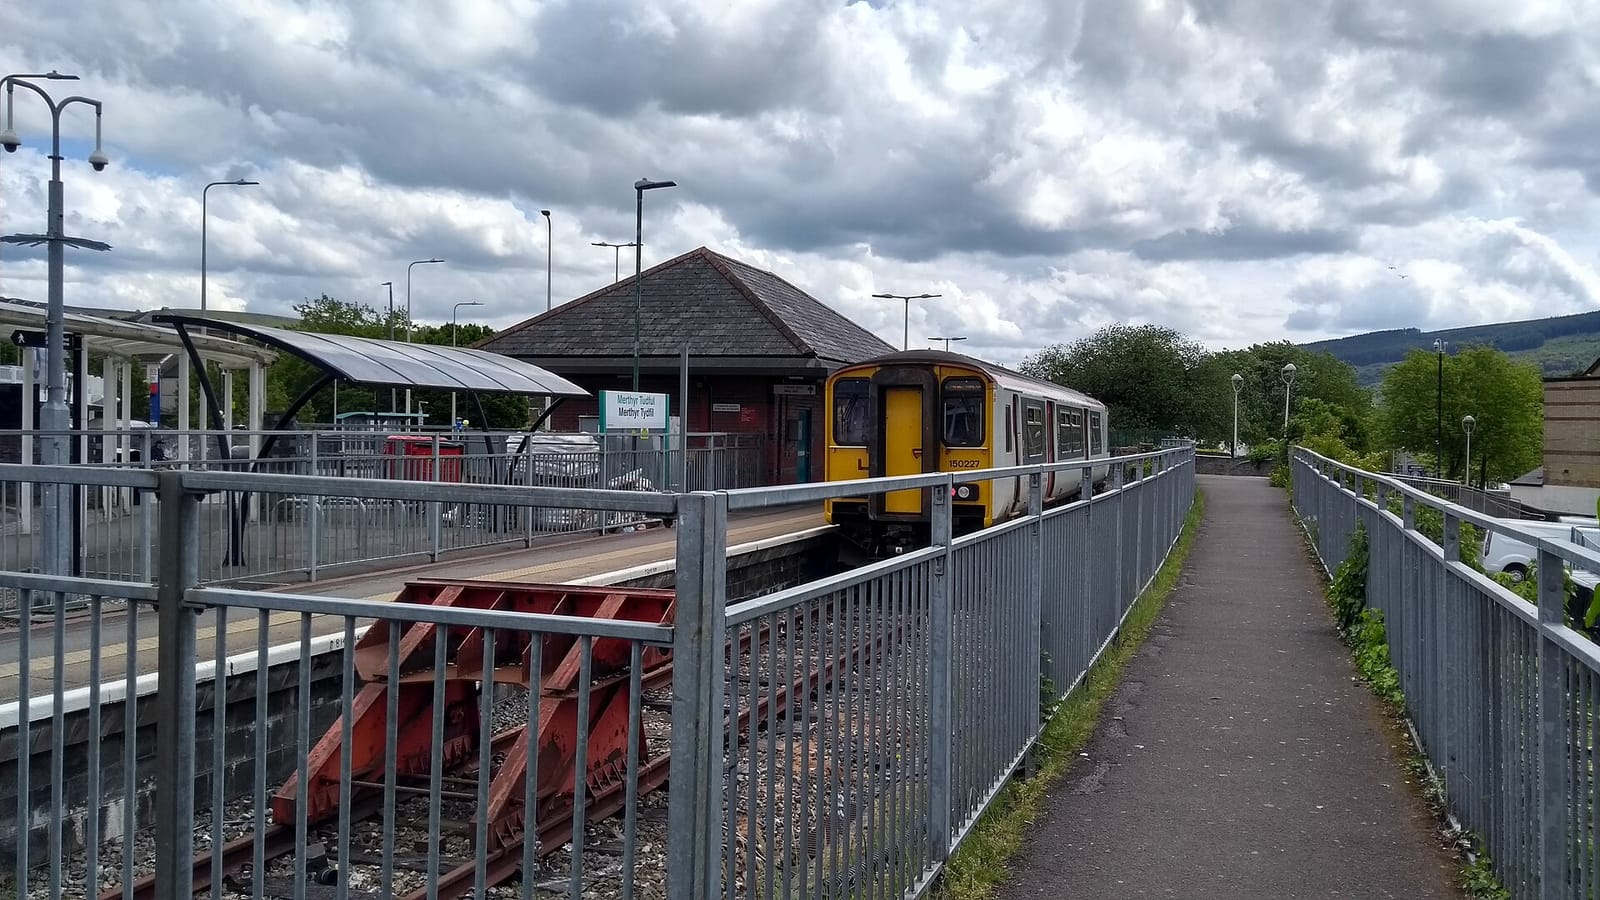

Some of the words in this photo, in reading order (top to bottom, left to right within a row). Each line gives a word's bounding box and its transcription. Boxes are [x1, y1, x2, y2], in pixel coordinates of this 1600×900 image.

[617, 394, 638, 406] Merthyr
[639, 395, 656, 405] Tudful
[618, 407, 639, 419] Merthyr
[640, 408, 655, 419] Tydfil
[949, 460, 980, 468] 150227
